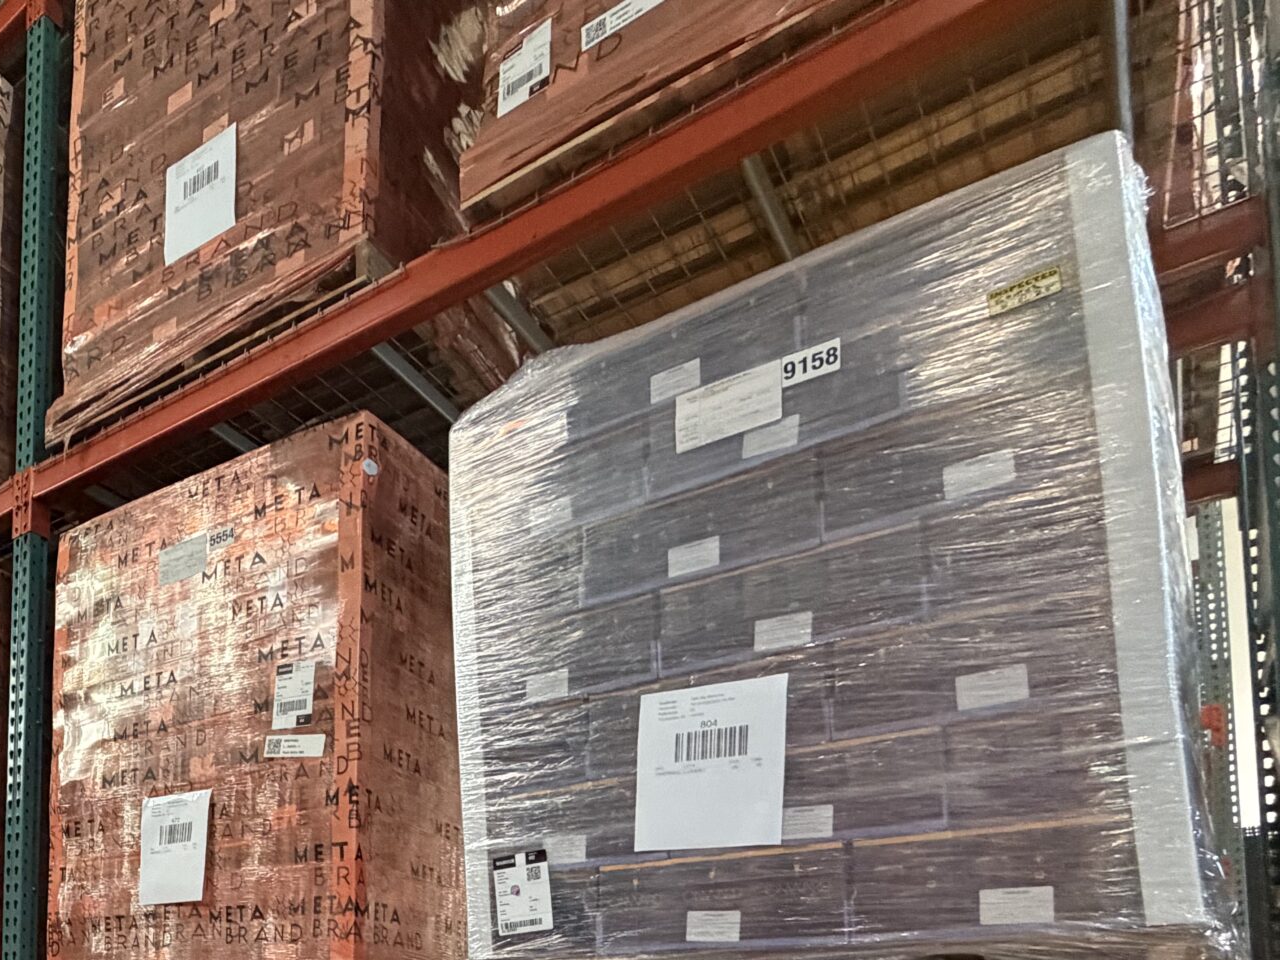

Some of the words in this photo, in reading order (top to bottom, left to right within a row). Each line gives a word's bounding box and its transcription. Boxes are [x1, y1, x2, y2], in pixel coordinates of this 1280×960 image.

[153, 3, 252, 79] META
[197, 9, 303, 87] META
[245, 16, 363, 94] META
[783, 347, 838, 380] 9158
[255, 482, 321, 520] META
[399, 498, 433, 538] META
[209, 528, 236, 547] 5554
[371, 528, 414, 573] META
[118, 538, 168, 569] META
[202, 551, 267, 584] META
[232, 592, 284, 621] META
[364, 573, 403, 615] META
[108, 629, 158, 656] META
[258, 632, 325, 663] META
[121, 670, 178, 697] META
[400, 653, 436, 687] META
[114, 719, 168, 742] META
[405, 703, 446, 739] META
[700, 719, 718, 729] 804
[383, 743, 422, 777] META
[102, 767, 157, 789] META
[61, 820, 105, 838] META
[436, 819, 461, 841] MET
[294, 841, 364, 864] META
[410, 860, 443, 887] META
[209, 904, 265, 924] META
[288, 895, 357, 918] META
[354, 901, 401, 926] META
[91, 914, 139, 935] META
[225, 923, 303, 945] BRAND
